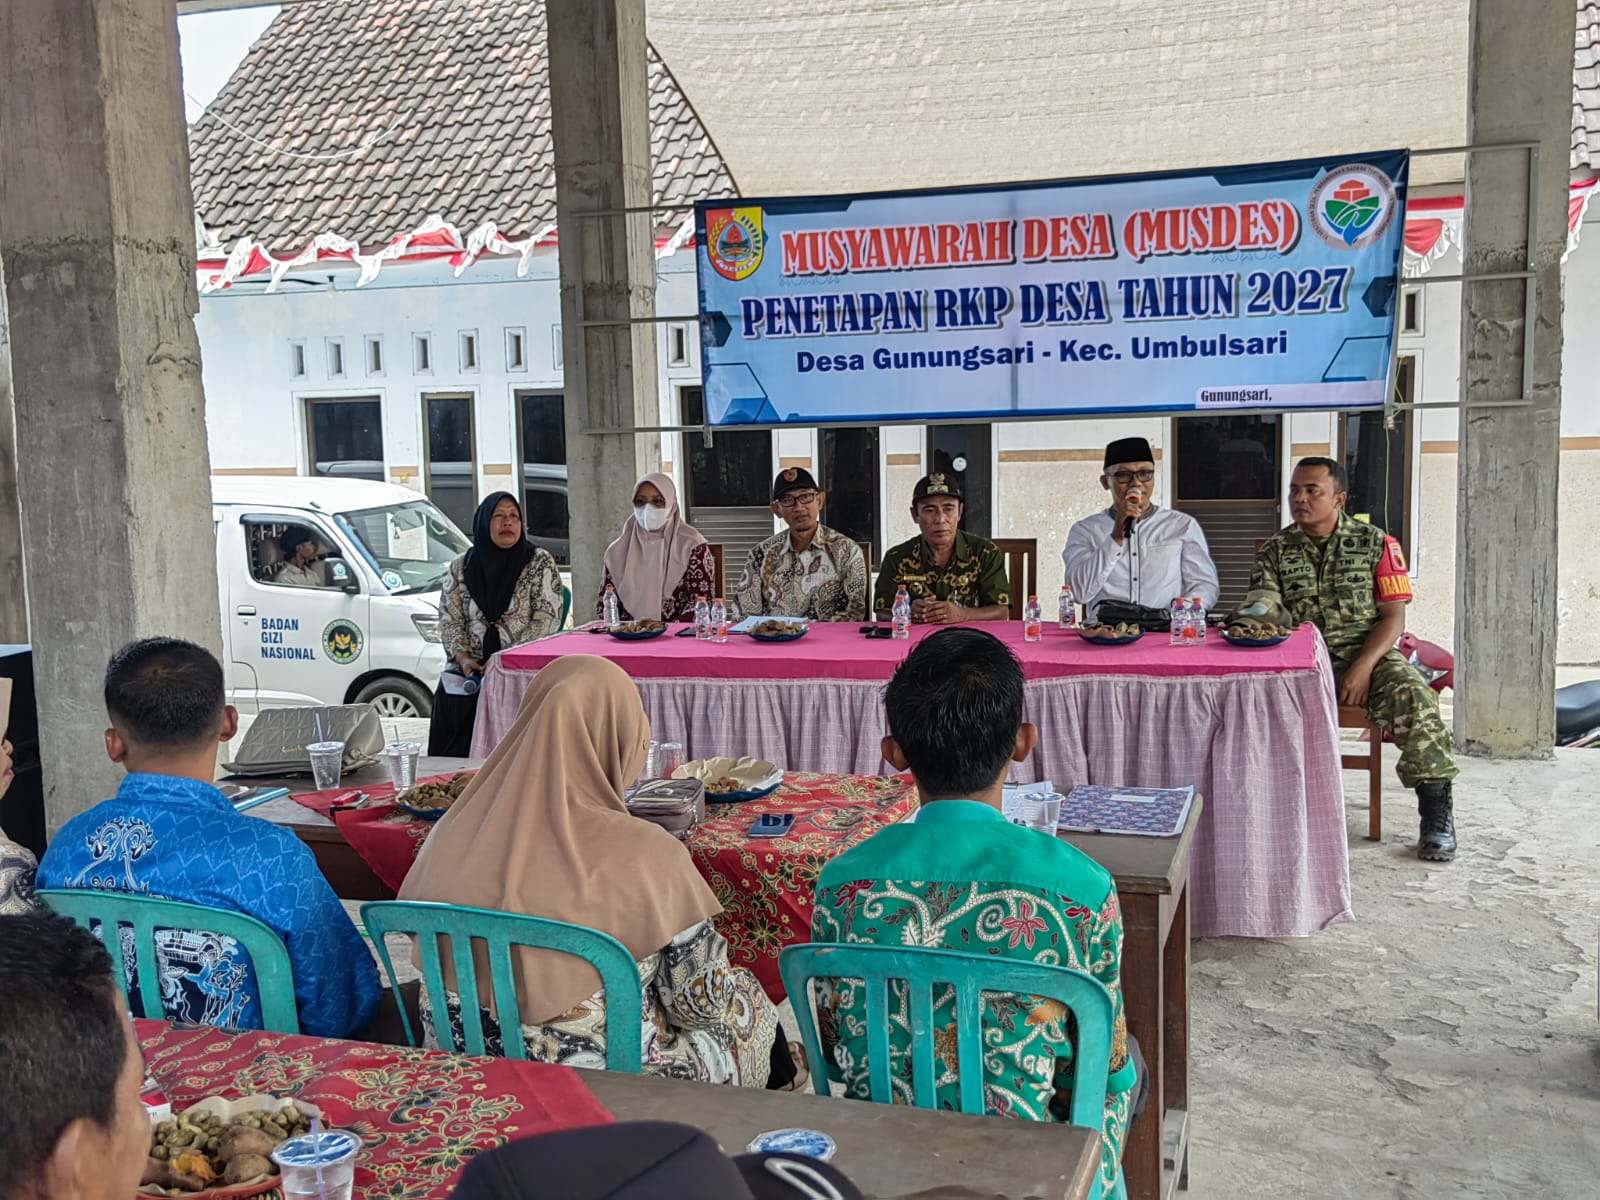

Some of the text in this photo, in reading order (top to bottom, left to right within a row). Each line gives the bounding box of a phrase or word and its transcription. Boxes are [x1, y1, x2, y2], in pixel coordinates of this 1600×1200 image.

[781, 219, 1012, 274] MUSYAWARAH
[1022, 213, 1114, 261] DESA
[1122, 200, 1299, 262] (MUSDES)
[741, 267, 1349, 337] PENETAPAN RKP DESA TAHUN 2027
[797, 351, 864, 373] Desa
[873, 341, 1034, 371] Gunungsari
[1059, 339, 1122, 362] Kec.
[1131, 331, 1287, 360] Umbulsari
[1201, 388, 1272, 402] Gunungsari,
[261, 617, 299, 631] BADAN
[261, 631, 283, 644] GIZI
[261, 646, 316, 660] NASIONAL
